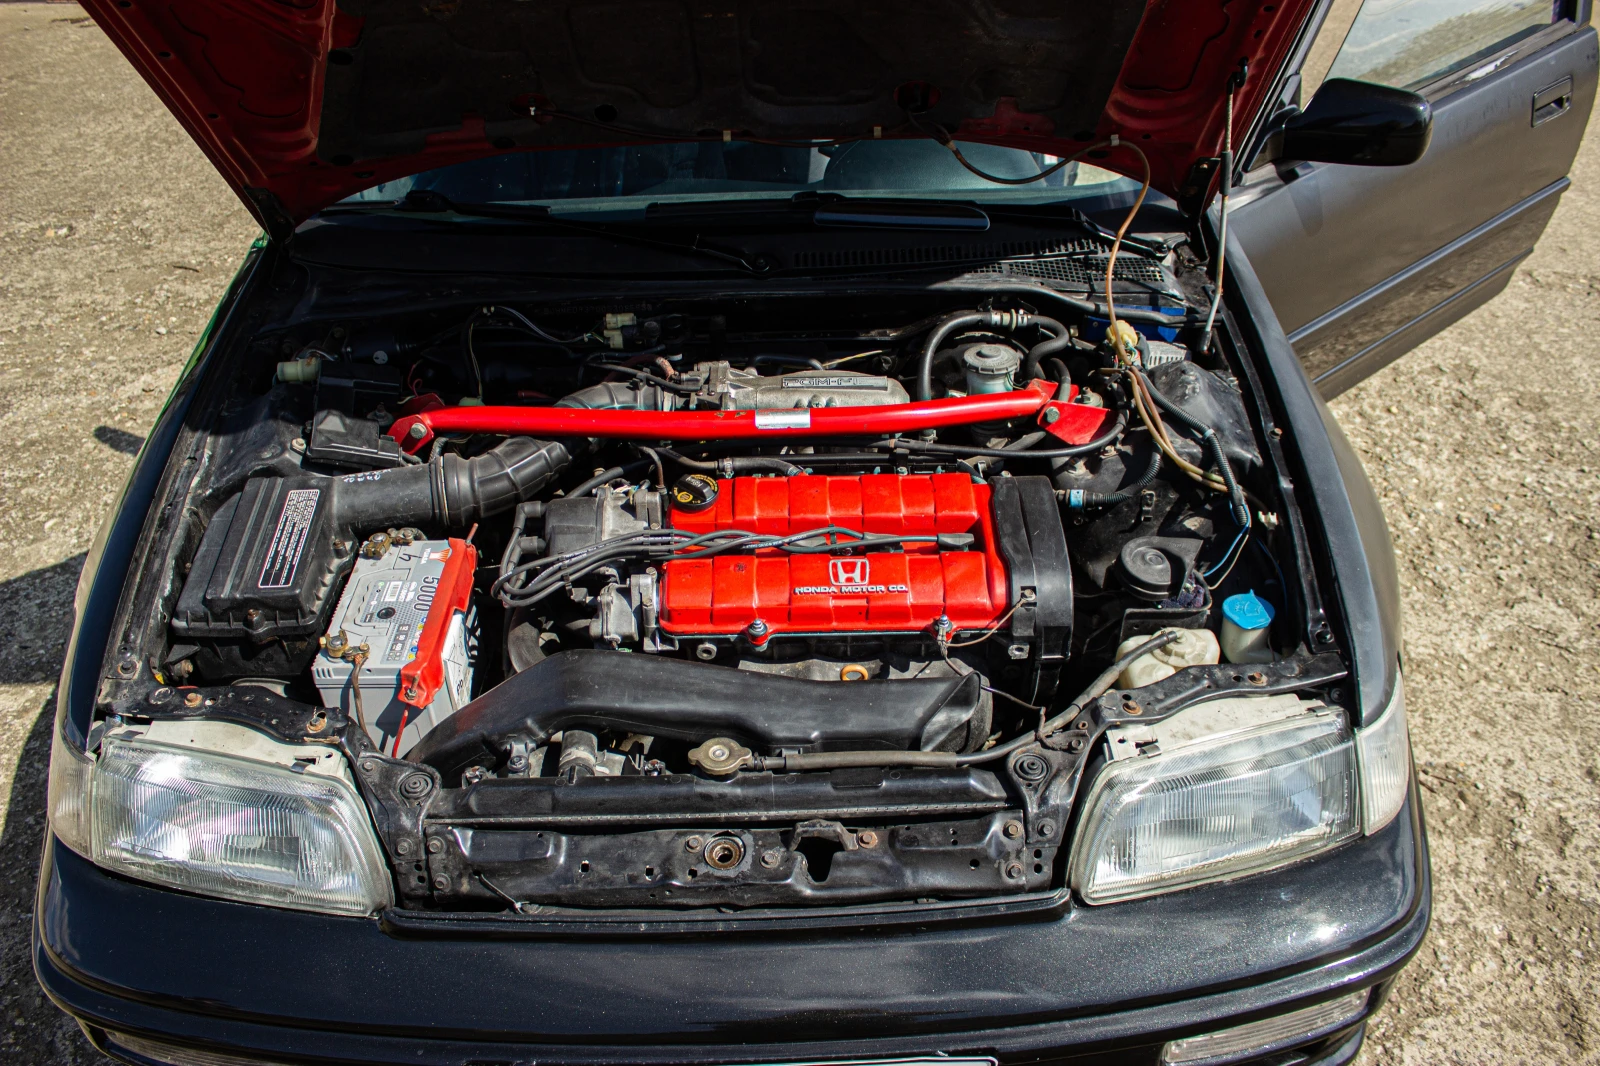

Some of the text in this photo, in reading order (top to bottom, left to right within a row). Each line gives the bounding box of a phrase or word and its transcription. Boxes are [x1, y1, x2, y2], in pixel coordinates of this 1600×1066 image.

[413, 576, 440, 612] 5000
[793, 583, 909, 595] HONDA MOTOR CO.
